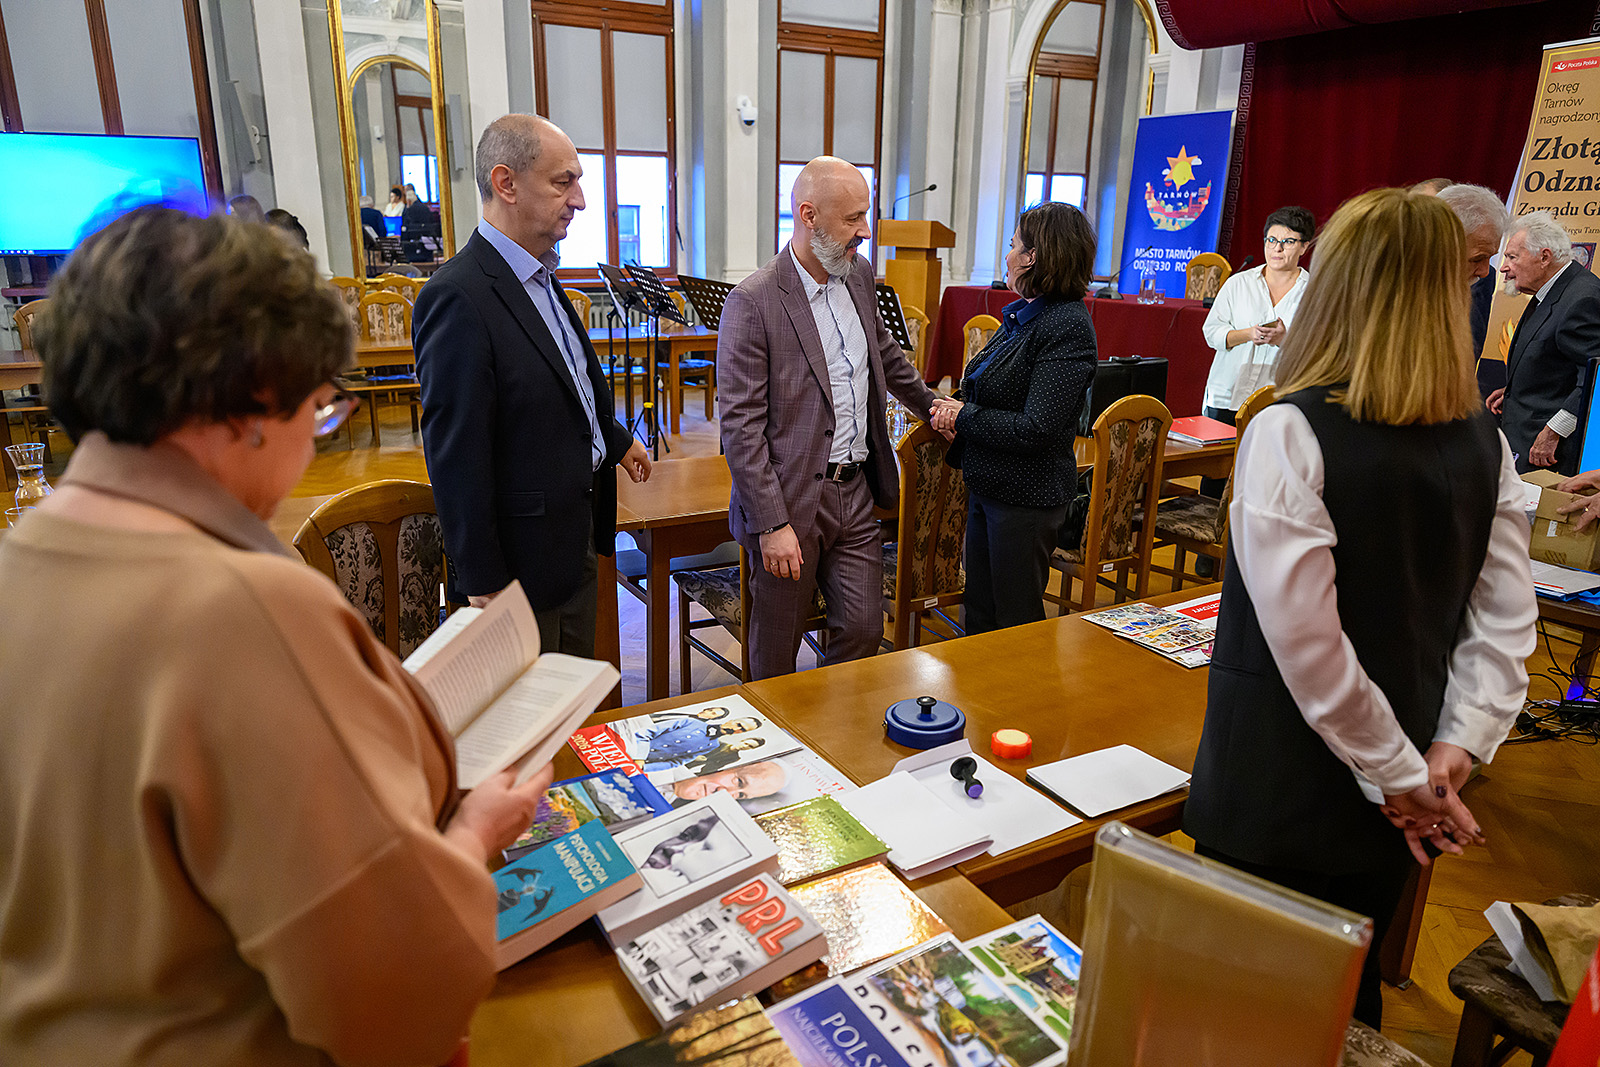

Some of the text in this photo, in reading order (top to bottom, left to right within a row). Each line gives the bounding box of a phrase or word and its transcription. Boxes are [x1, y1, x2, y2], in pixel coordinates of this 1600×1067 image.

[1546, 82, 1580, 94] Okręg
[1543, 97, 1585, 109] Tarnów
[1158, 190, 1198, 199] TARNÓW
[1134, 247, 1164, 259] MIASTO
[569, 733, 591, 750] 2026
[553, 841, 596, 894] MANIPULACJI
[569, 833, 609, 885] PSYCHOLOGIA
[720, 878, 804, 957] PRL
[820, 1011, 888, 1067] POLS
